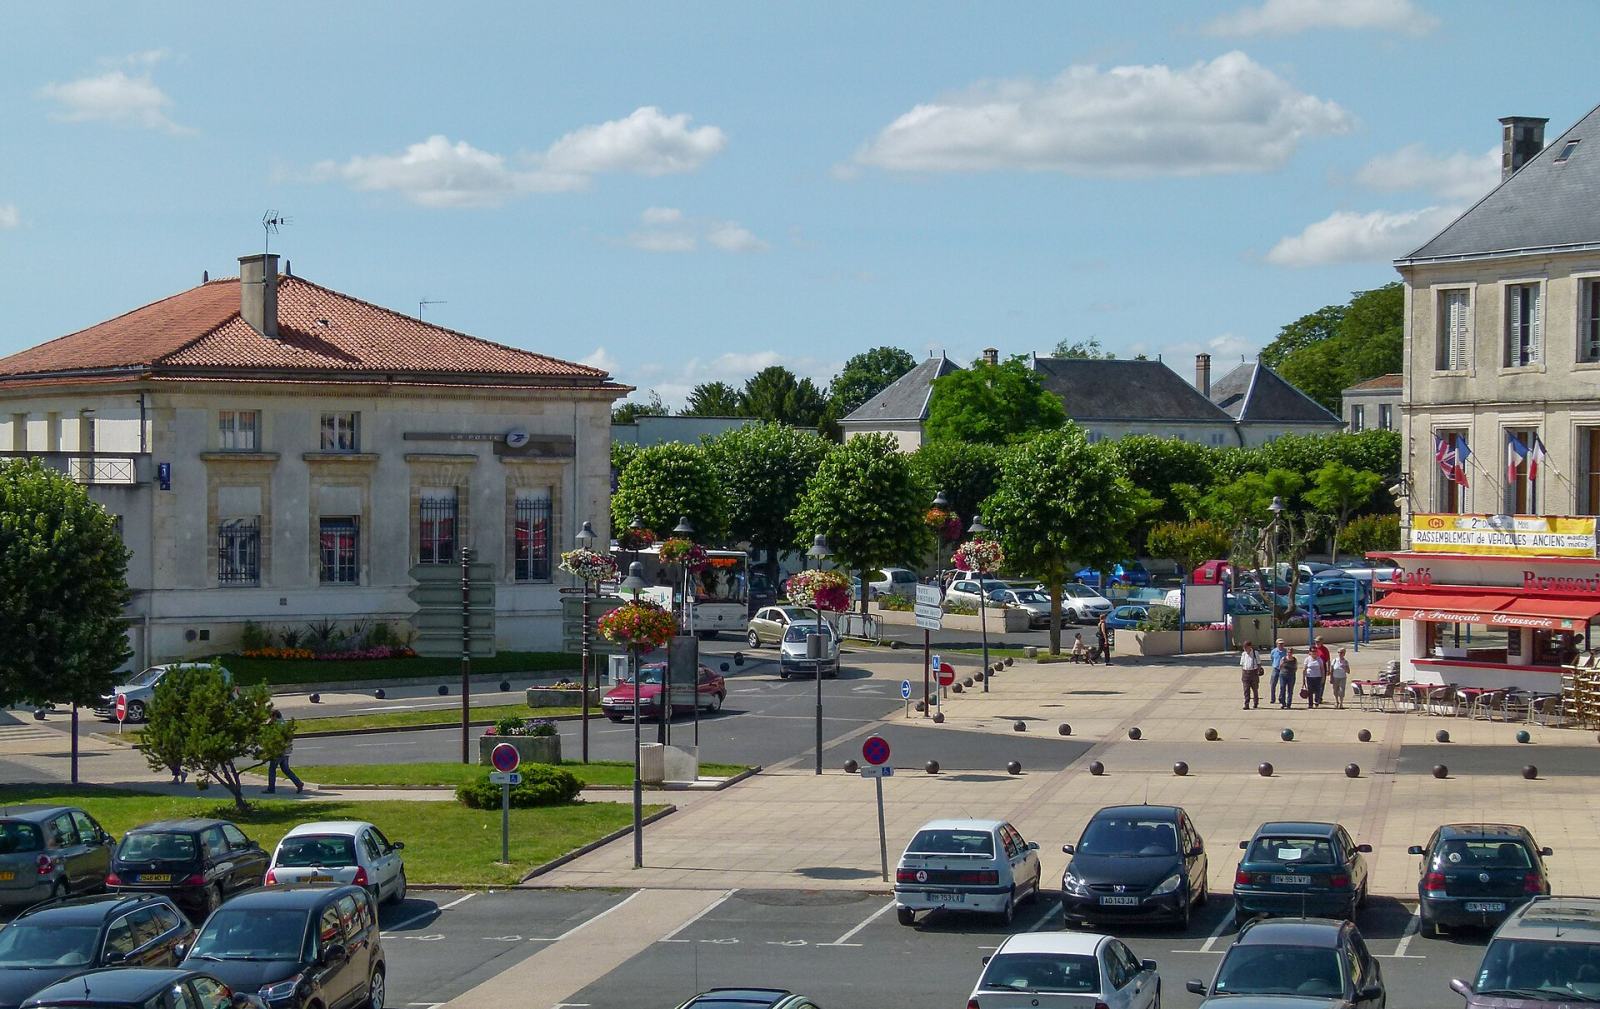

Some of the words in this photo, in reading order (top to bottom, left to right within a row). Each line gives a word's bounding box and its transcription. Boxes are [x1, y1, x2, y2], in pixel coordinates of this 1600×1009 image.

[1416, 531, 1475, 544] RASSEMBLEMENT
[1477, 533, 1485, 544] de
[1533, 535, 1566, 547] ANCIENS
[1391, 567, 1432, 587] Café
[1374, 608, 1400, 618] Café
[1427, 612, 1481, 623] Français
[1491, 614, 1553, 628] Brasserie
